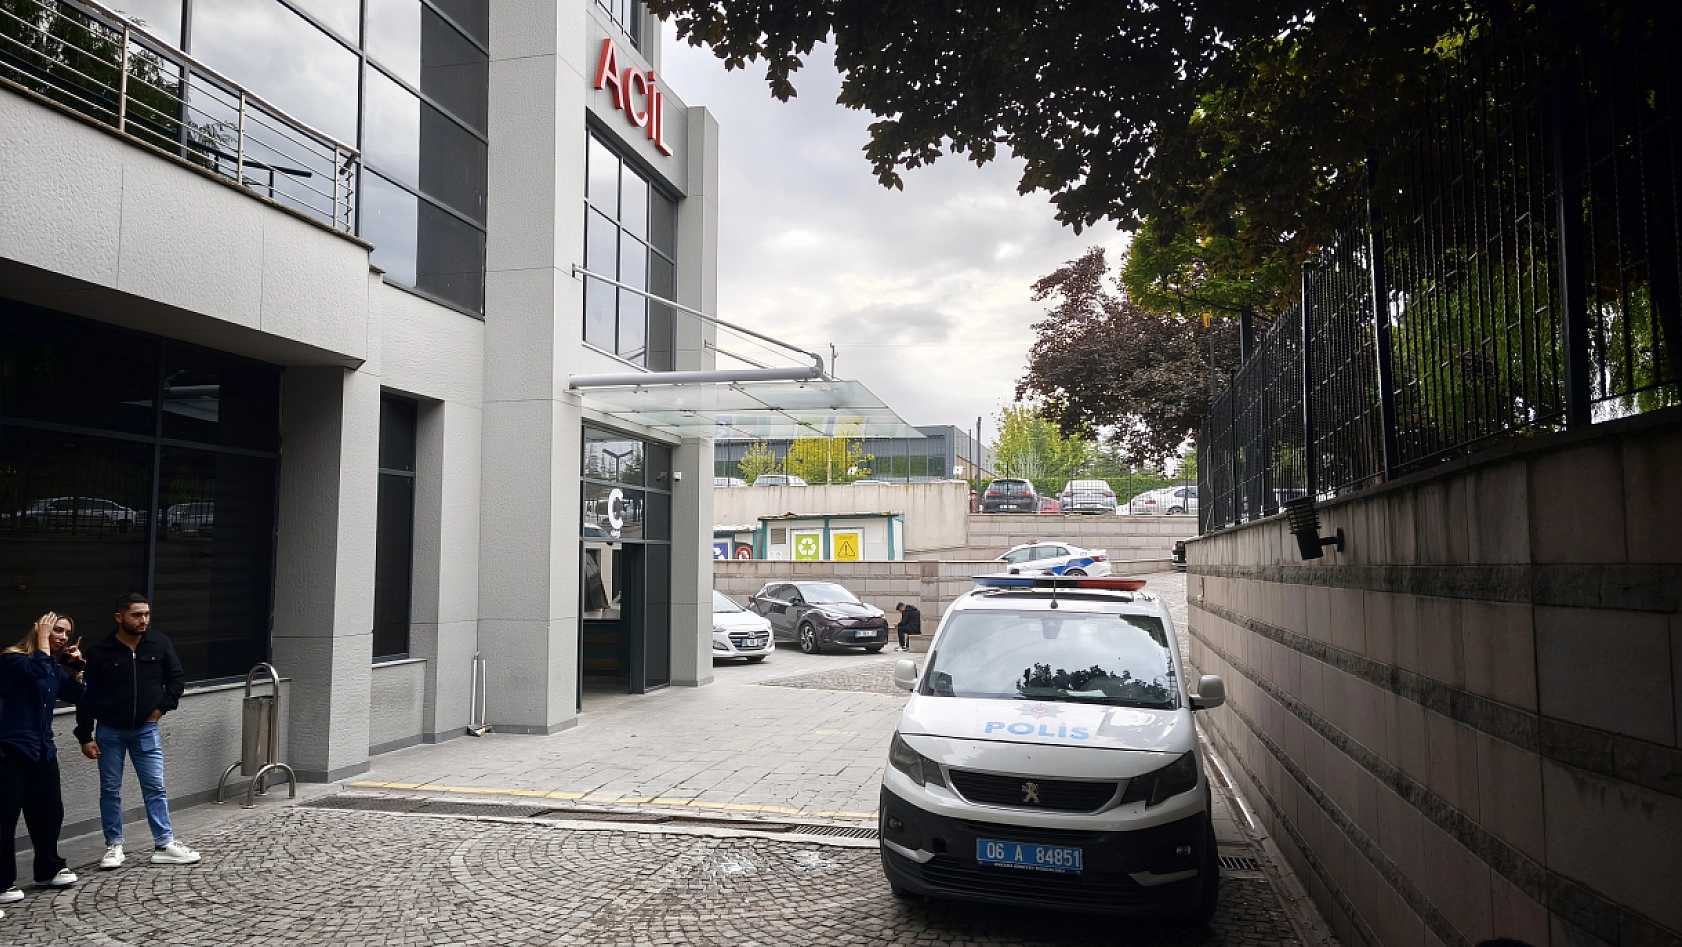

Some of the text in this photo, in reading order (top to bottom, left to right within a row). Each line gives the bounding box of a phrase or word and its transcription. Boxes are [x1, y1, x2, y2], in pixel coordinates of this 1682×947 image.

[594, 38, 674, 157] ACİL
[984, 721, 1090, 740] POLİS
[986, 842, 1005, 860] 06
[1014, 844, 1024, 862] A
[1035, 847, 1080, 868] 84851
